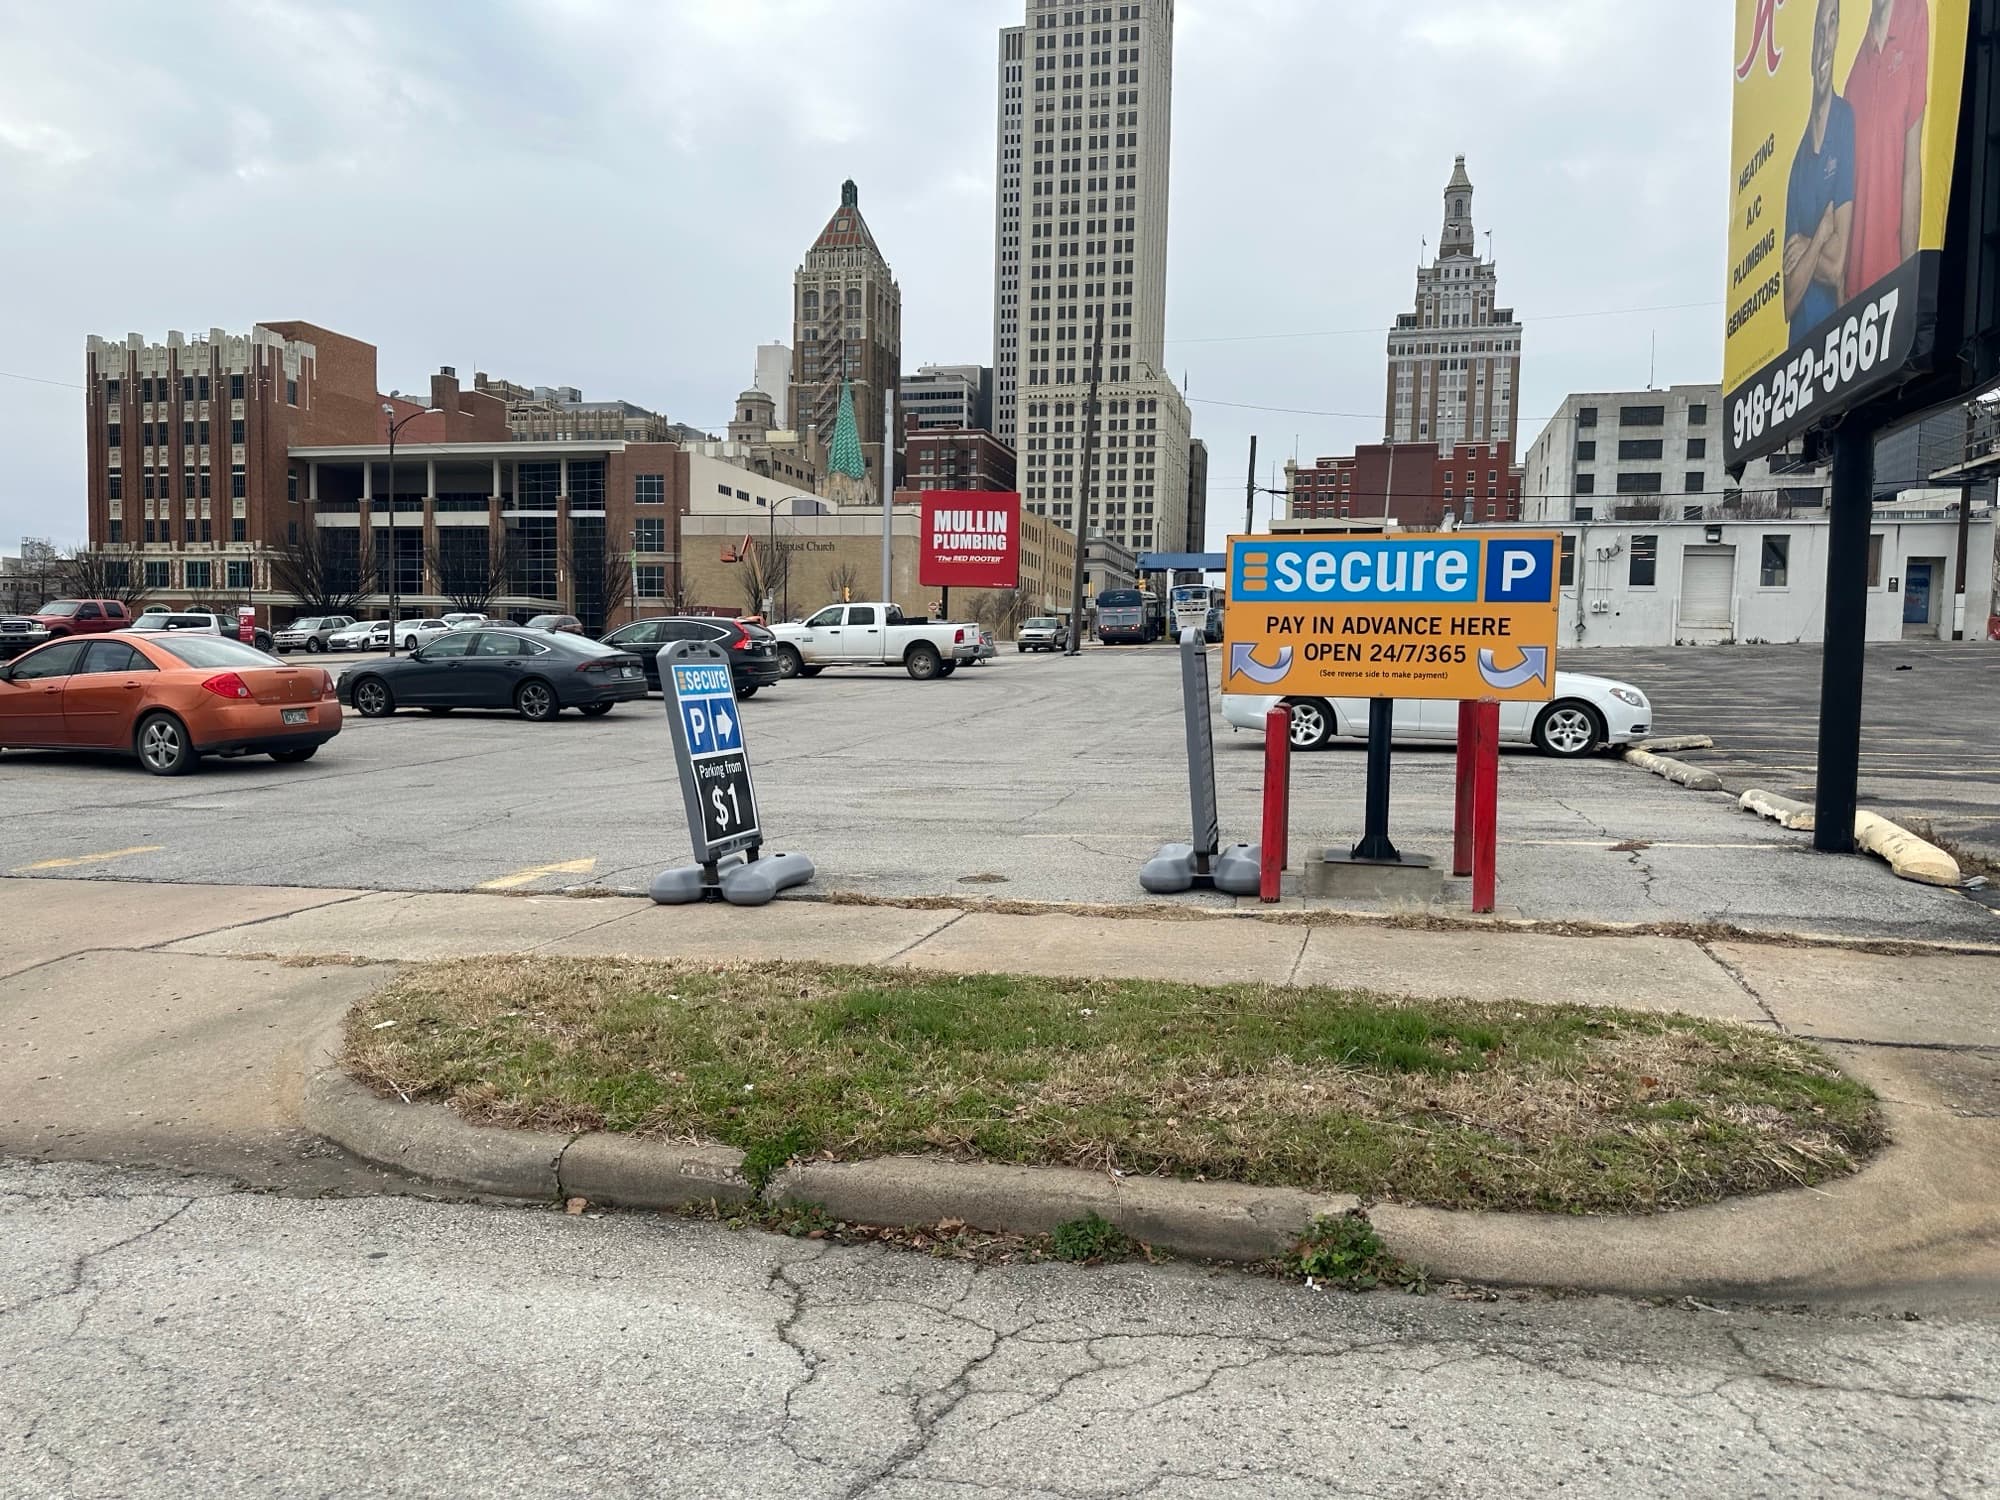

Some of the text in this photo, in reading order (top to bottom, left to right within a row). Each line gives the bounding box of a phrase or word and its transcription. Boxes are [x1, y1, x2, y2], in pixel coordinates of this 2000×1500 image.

[1738, 131, 1775, 195] HEATING
[1746, 193, 1762, 231] A/C
[1733, 227, 1775, 290] PLUMBING
[1727, 271, 1780, 340] GENERATORS
[1733, 287, 1899, 450] 918-252-5667
[933, 510, 1008, 533] MULLIN
[806, 541, 835, 552] Church
[933, 533, 1007, 550] PLUMBING
[952, 555, 969, 563] RED
[1274, 550, 1536, 593] secure P
[1266, 616, 1511, 637] PAY IN ADVANCE HERE
[1304, 643, 1467, 664] OPEN 24/7/365
[687, 670, 728, 692] secure
[1319, 669, 1335, 678] (See
[1365, 670, 1380, 678] side
[1382, 670, 1390, 678] to
[1392, 671, 1412, 679] make
[1413, 671, 1449, 681] payment)
[689, 707, 705, 746] P
[699, 760, 742, 780] Parking from
[712, 782, 741, 831] $1
